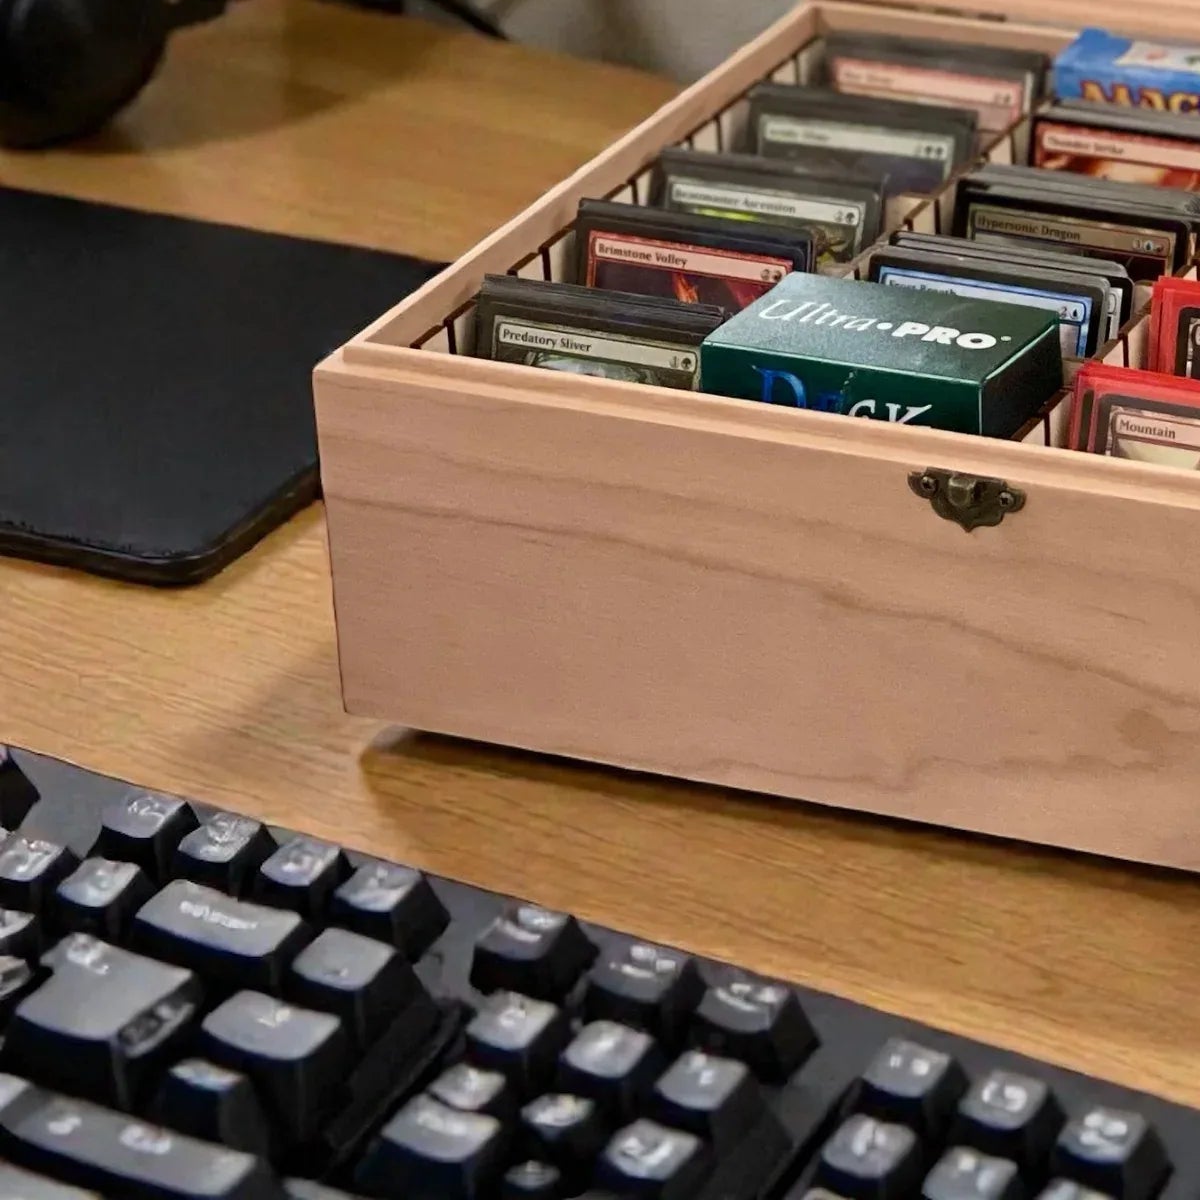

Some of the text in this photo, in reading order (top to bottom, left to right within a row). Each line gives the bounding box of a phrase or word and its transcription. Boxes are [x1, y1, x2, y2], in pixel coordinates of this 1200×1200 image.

[977, 215, 1080, 241] Hypersonic Dragon
[598, 243, 653, 261] Brimstone
[502, 328, 592, 352] Predatory Sliver
[1119, 419, 1176, 439] Mountain
